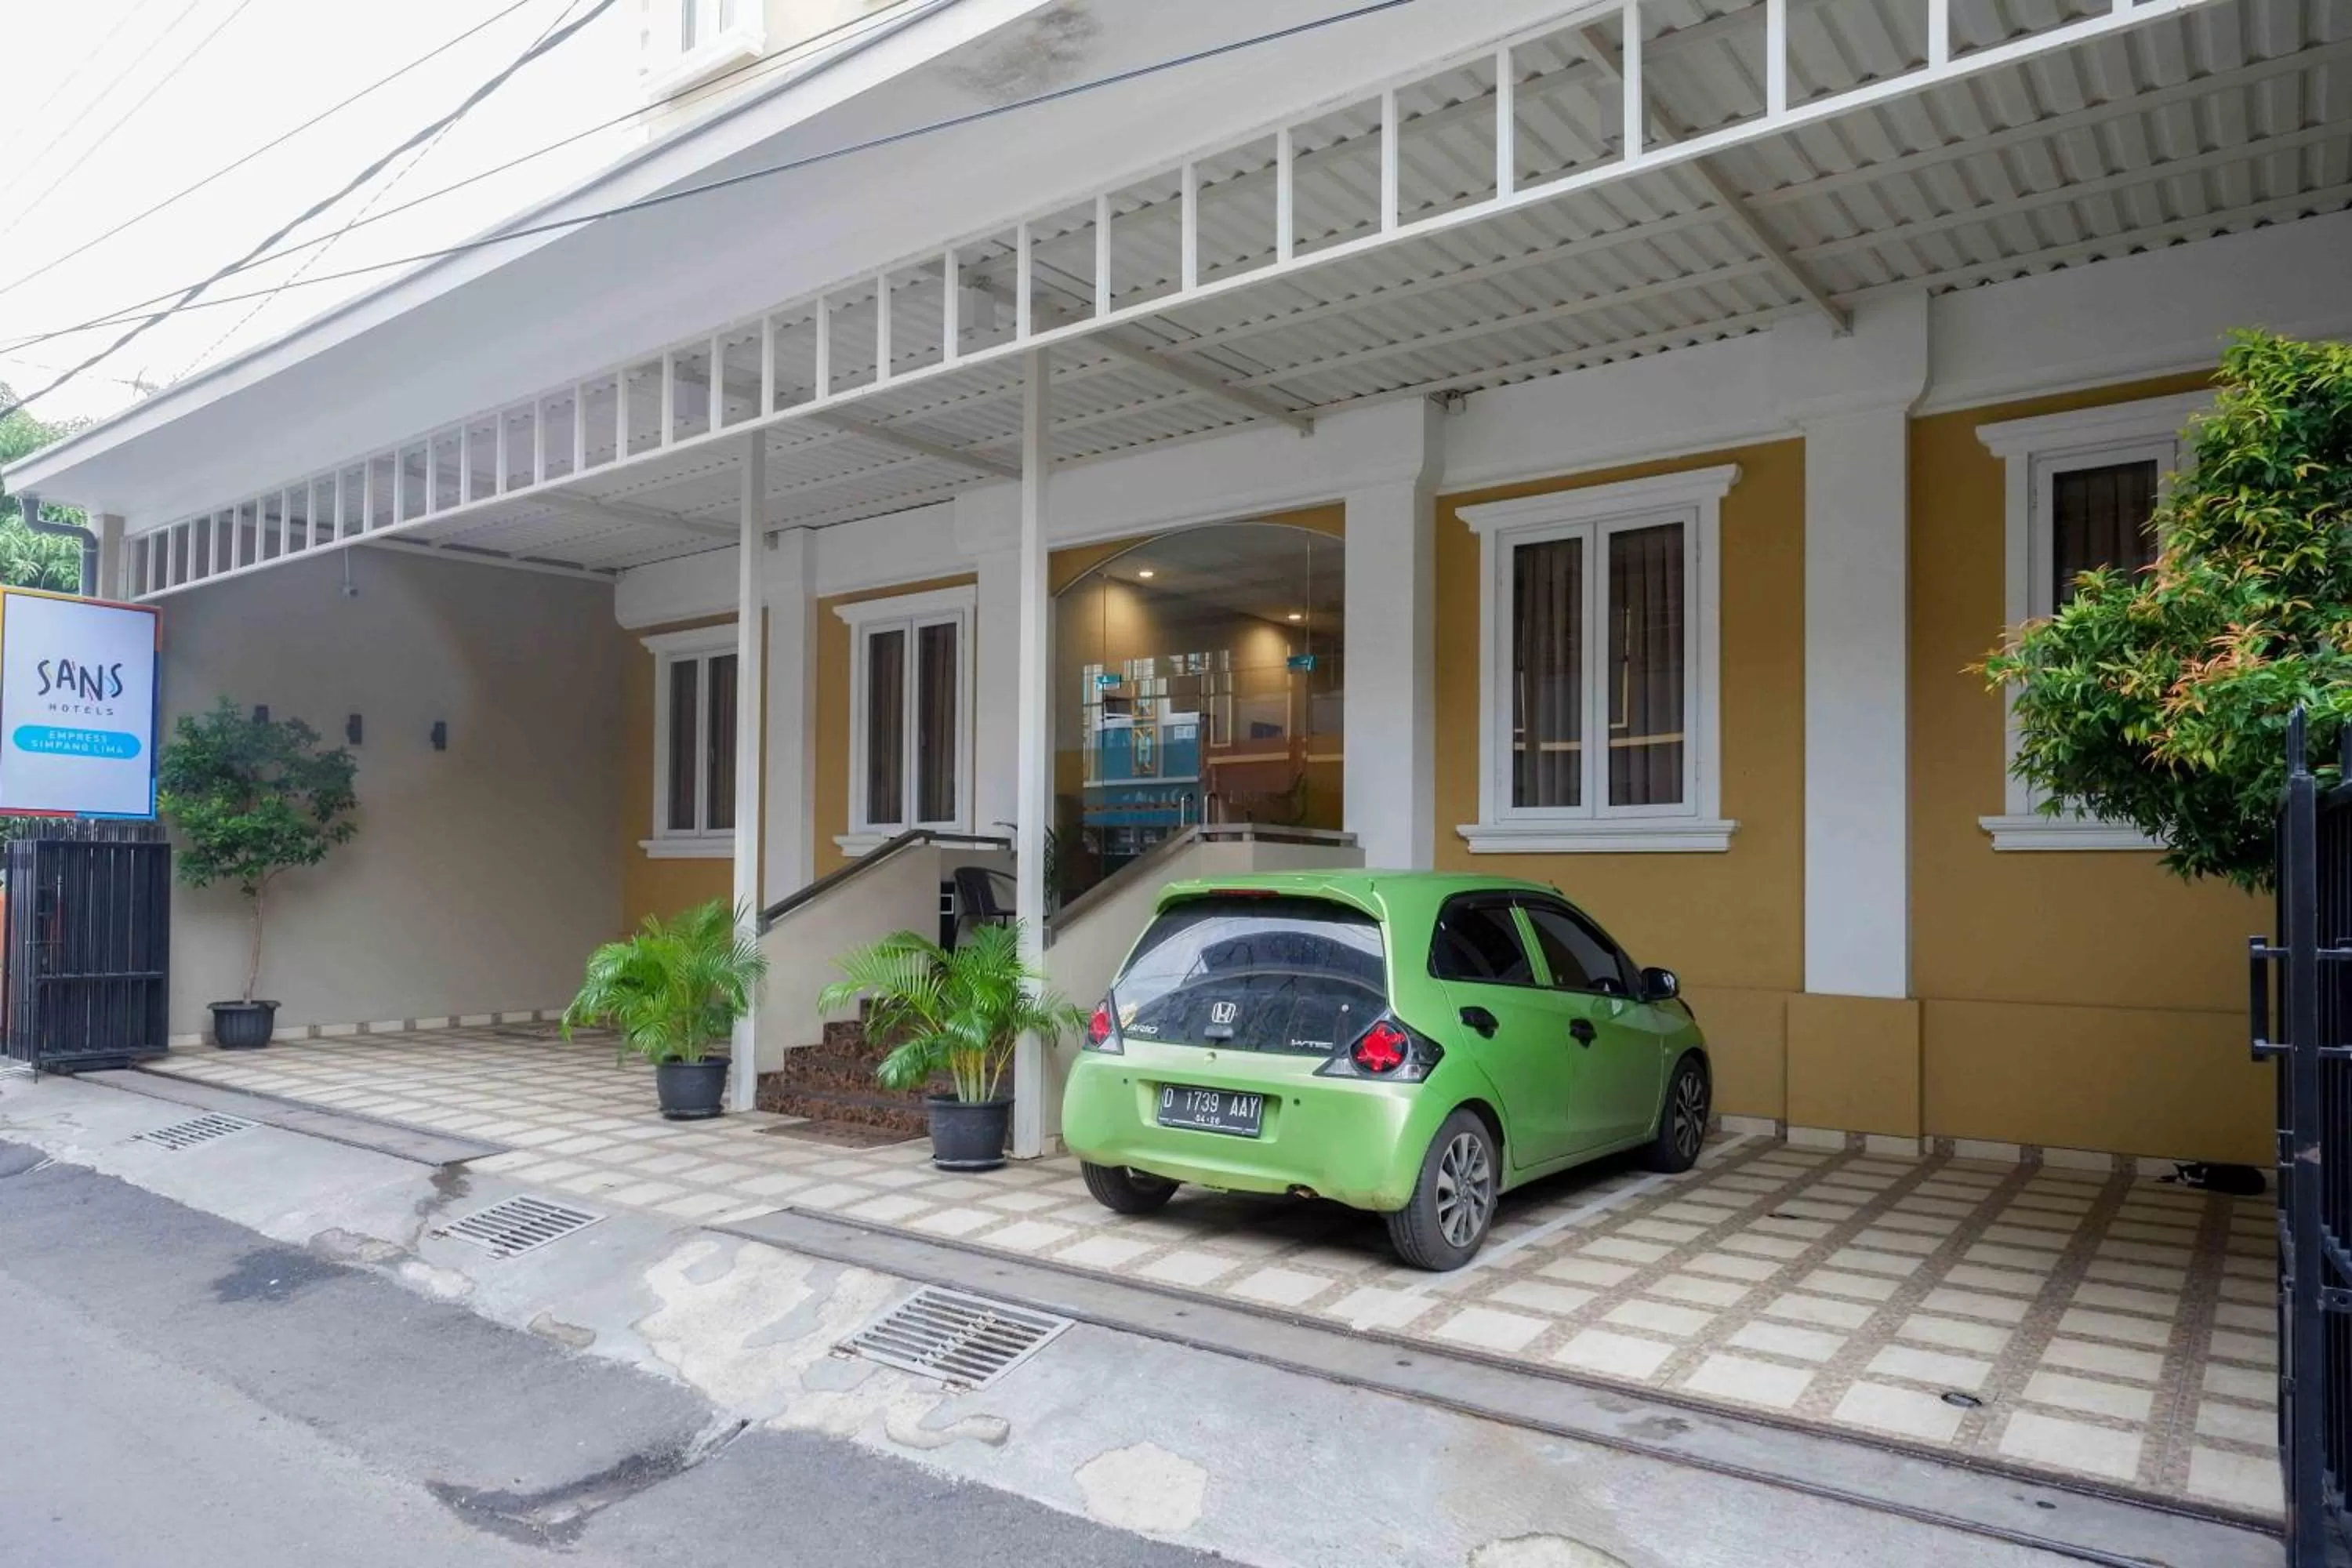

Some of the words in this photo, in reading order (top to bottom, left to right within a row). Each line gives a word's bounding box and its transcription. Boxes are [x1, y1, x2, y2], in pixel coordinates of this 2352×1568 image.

[37, 659, 123, 702] SANS
[49, 703, 114, 716] HOTELS
[49, 730, 107, 744] EMPRESS
[31, 739, 89, 753] SIMPANG
[93, 745, 124, 754] LIMA
[1163, 1087, 1174, 1108] D
[1186, 1091, 1219, 1113] 1739
[1229, 1095, 1258, 1119] AAY
